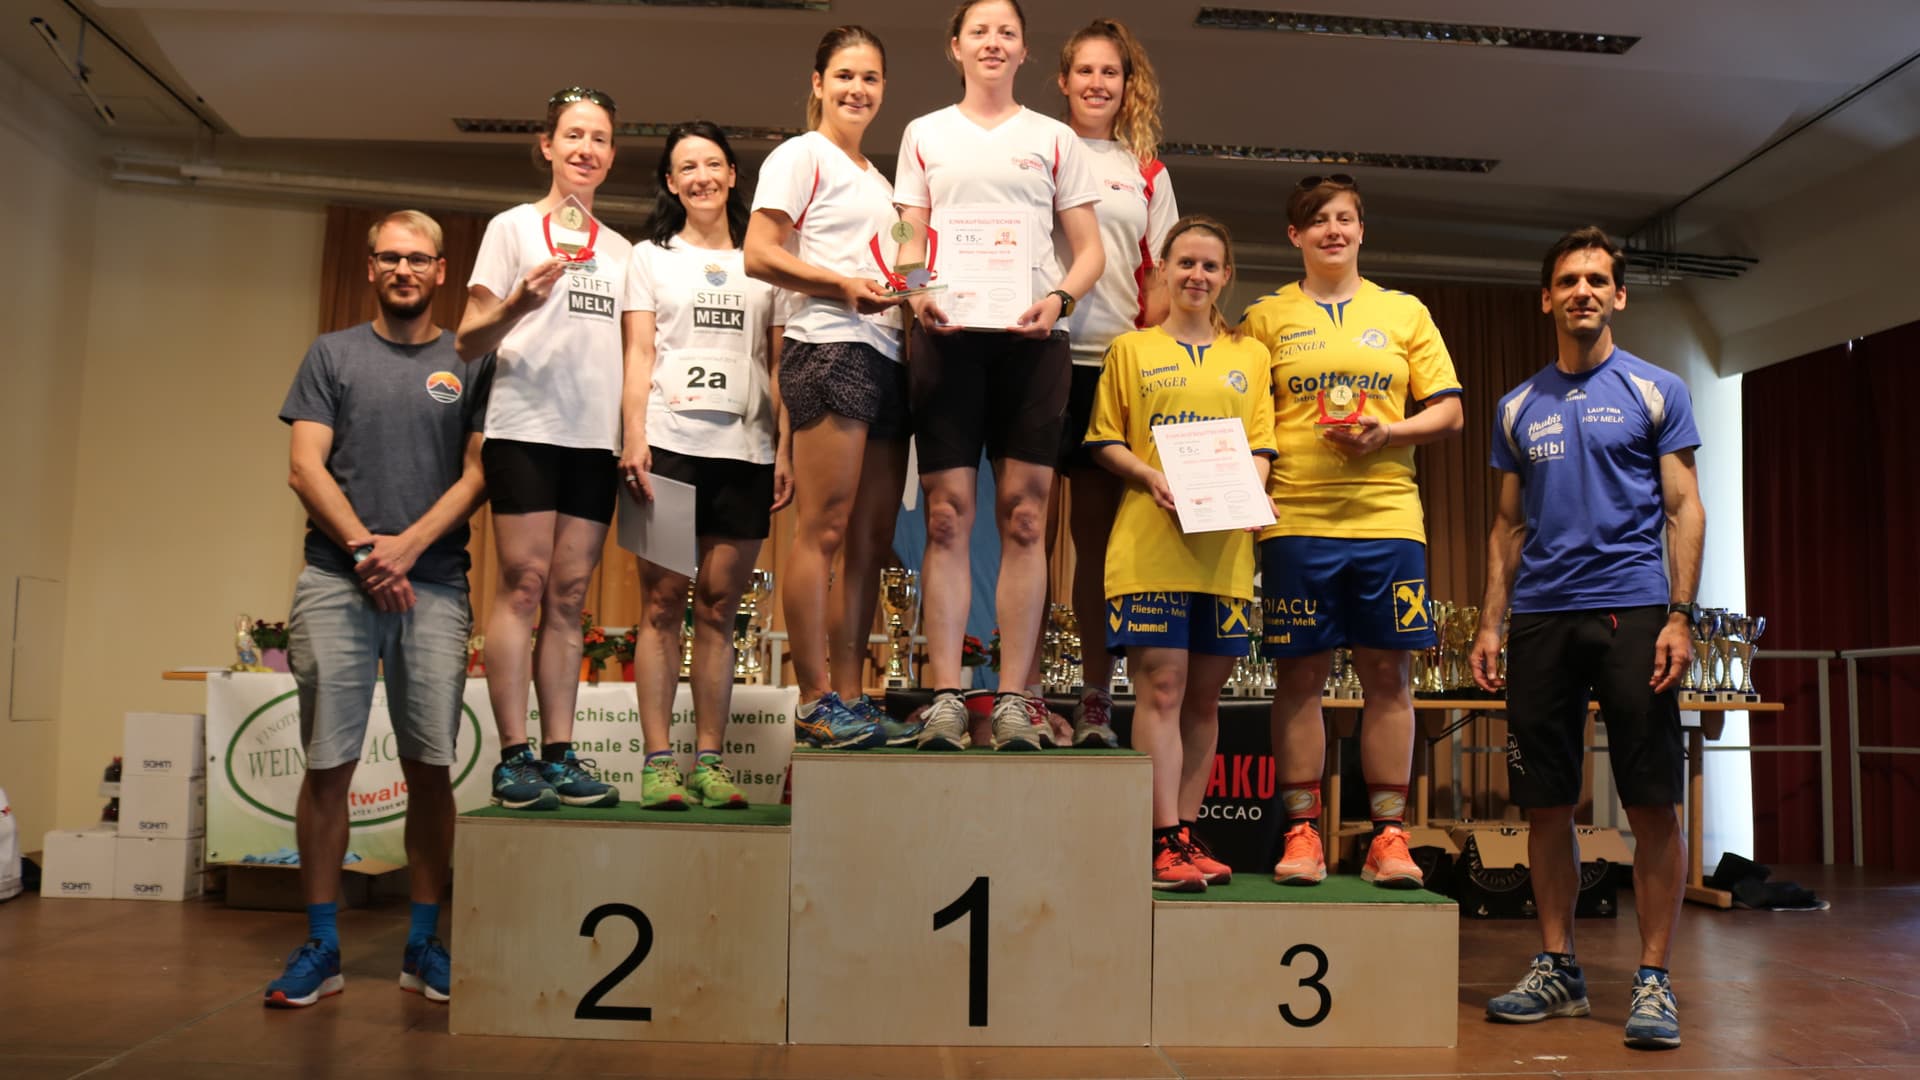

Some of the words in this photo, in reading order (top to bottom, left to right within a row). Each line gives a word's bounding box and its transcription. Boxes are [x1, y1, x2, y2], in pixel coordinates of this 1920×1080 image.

[572, 275, 612, 293] STIFT
[571, 294, 613, 315] MELK
[697, 292, 742, 306] STIFT
[696, 311, 742, 327] MELK
[1280, 328, 1316, 343] hummel
[687, 366, 727, 390] 2a
[1141, 363, 1179, 378] hummel
[1288, 371, 1393, 395] Gottwald
[1582, 415, 1599, 423] HSV
[1600, 415, 1625, 423] MELK
[1131, 604, 1163, 615] Fliesen
[1128, 620, 1168, 633] hummel
[1293, 617, 1317, 627] Melk
[932, 876, 990, 1027] 1
[574, 902, 654, 1022] 2
[1277, 943, 1332, 1028] 3
